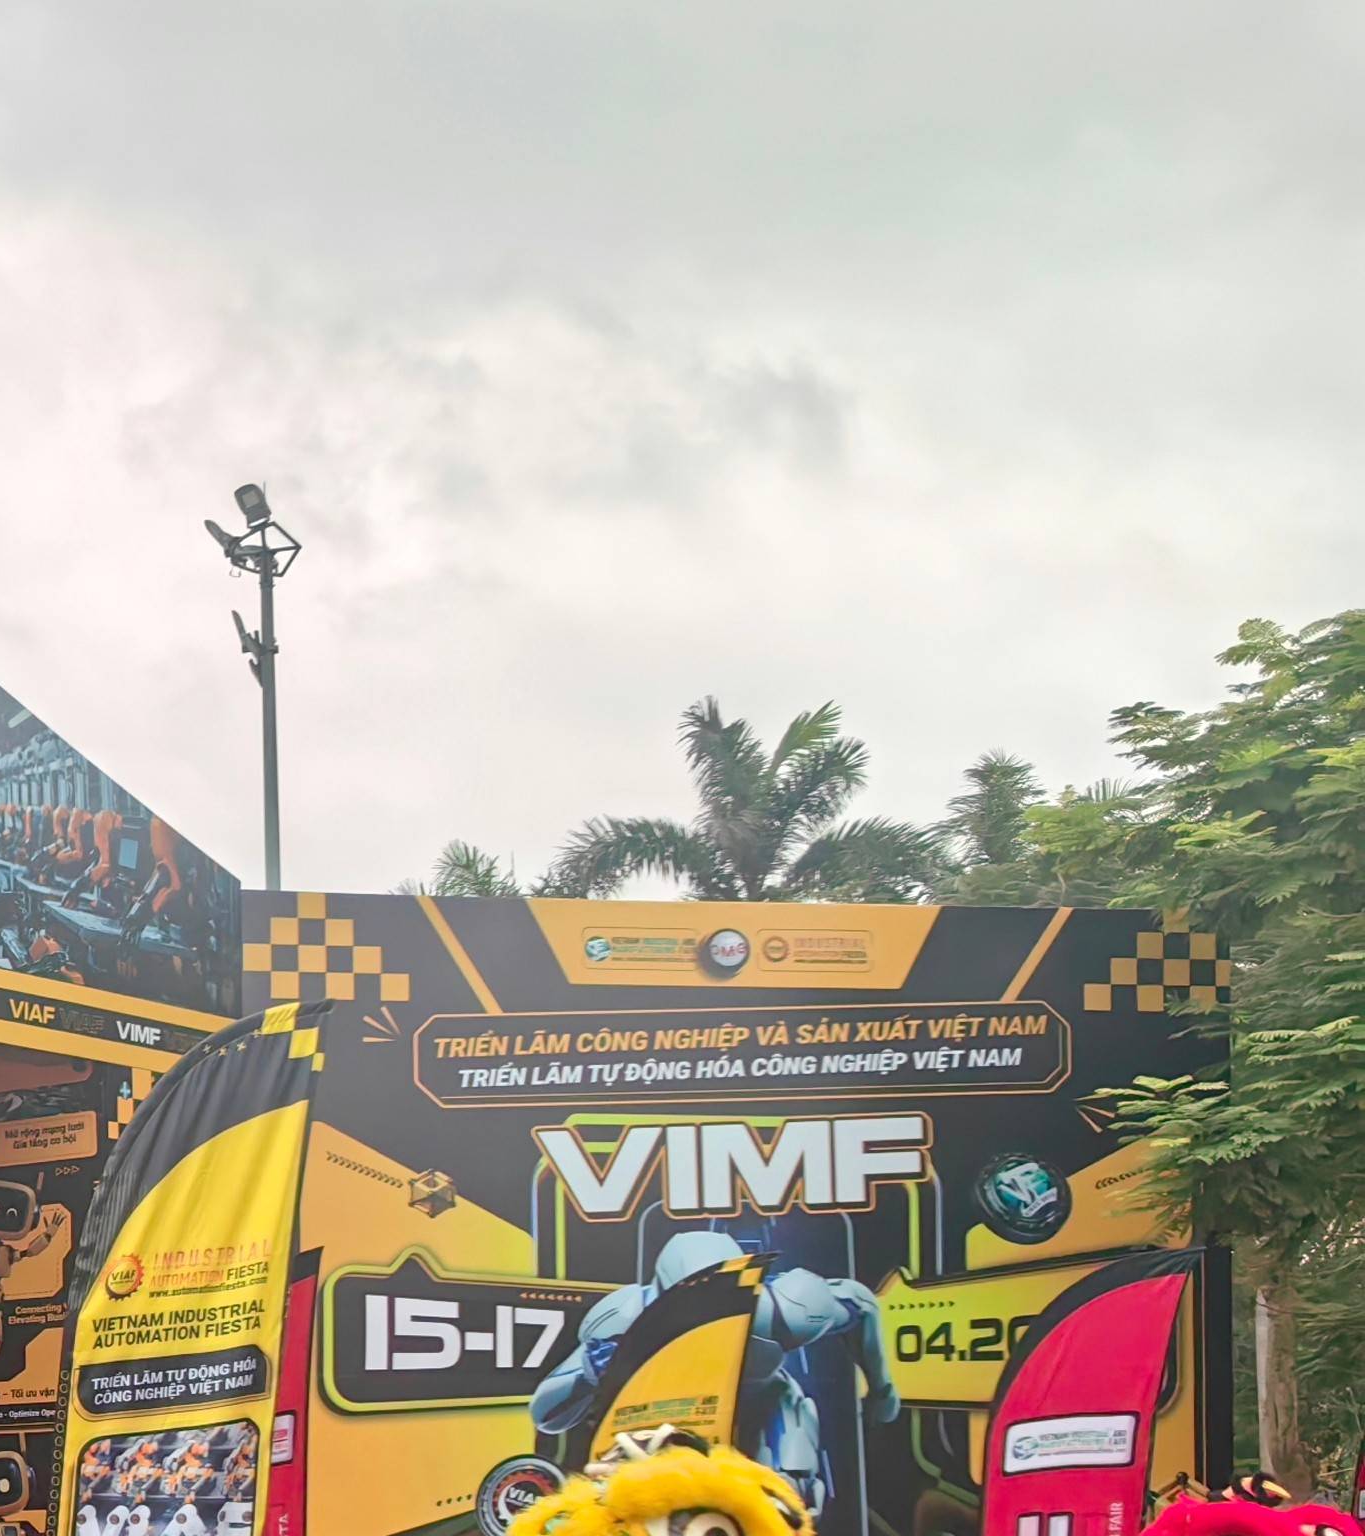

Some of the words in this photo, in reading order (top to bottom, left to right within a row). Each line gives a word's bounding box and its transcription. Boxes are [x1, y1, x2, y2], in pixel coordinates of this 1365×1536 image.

[9, 999, 56, 1025] VIAF
[116, 1021, 162, 1045] VIMF
[433, 1031, 510, 1058] TRIỂN
[514, 1028, 571, 1055] LÃM
[575, 1027, 648, 1053] CÔNG
[654, 1023, 752, 1051] NGHIỆP
[757, 1020, 788, 1047] VÀ
[857, 1013, 923, 1042] XUẤT
[928, 1012, 984, 1040] VIỆT
[988, 1014, 1048, 1037] NAM
[459, 1062, 527, 1088] TRIỂN
[532, 1060, 583, 1085] LÃM
[625, 1056, 690, 1084] ĐỘNG
[696, 1053, 745, 1079] HÓA
[751, 1051, 814, 1077] CÔNG
[820, 1047, 909, 1075] NGHIỆP
[914, 1043, 965, 1071] VIỆT
[969, 1048, 1022, 1067] NAM
[532, 1113, 933, 1223] VIMF
[92, 1310, 164, 1334] VIETNAM
[168, 1299, 265, 1328] INDUSTRIAL
[92, 1324, 202, 1349] AUTOMATION
[205, 1315, 261, 1338] FIESTA
[364, 1294, 566, 1370] 15-17
